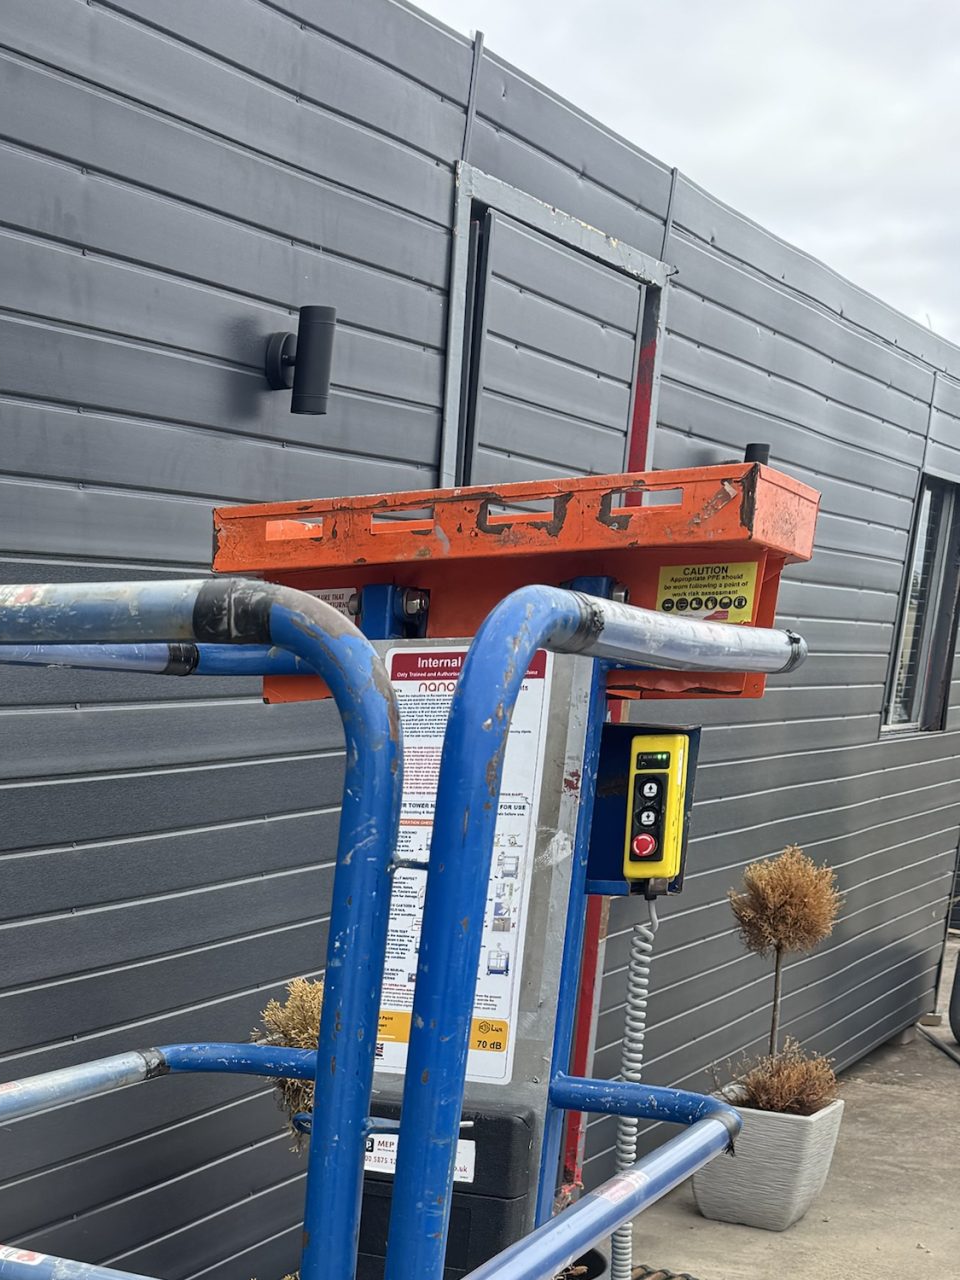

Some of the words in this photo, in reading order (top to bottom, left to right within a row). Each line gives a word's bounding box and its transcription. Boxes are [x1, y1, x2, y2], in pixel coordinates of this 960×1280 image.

[683, 565, 729, 575] CAUTION
[417, 656, 461, 668] Internal
[418, 681, 456, 692] nano
[477, 1040, 488, 1049] 70
[489, 1041, 502, 1050] dB
[377, 1140, 395, 1148] MEP
